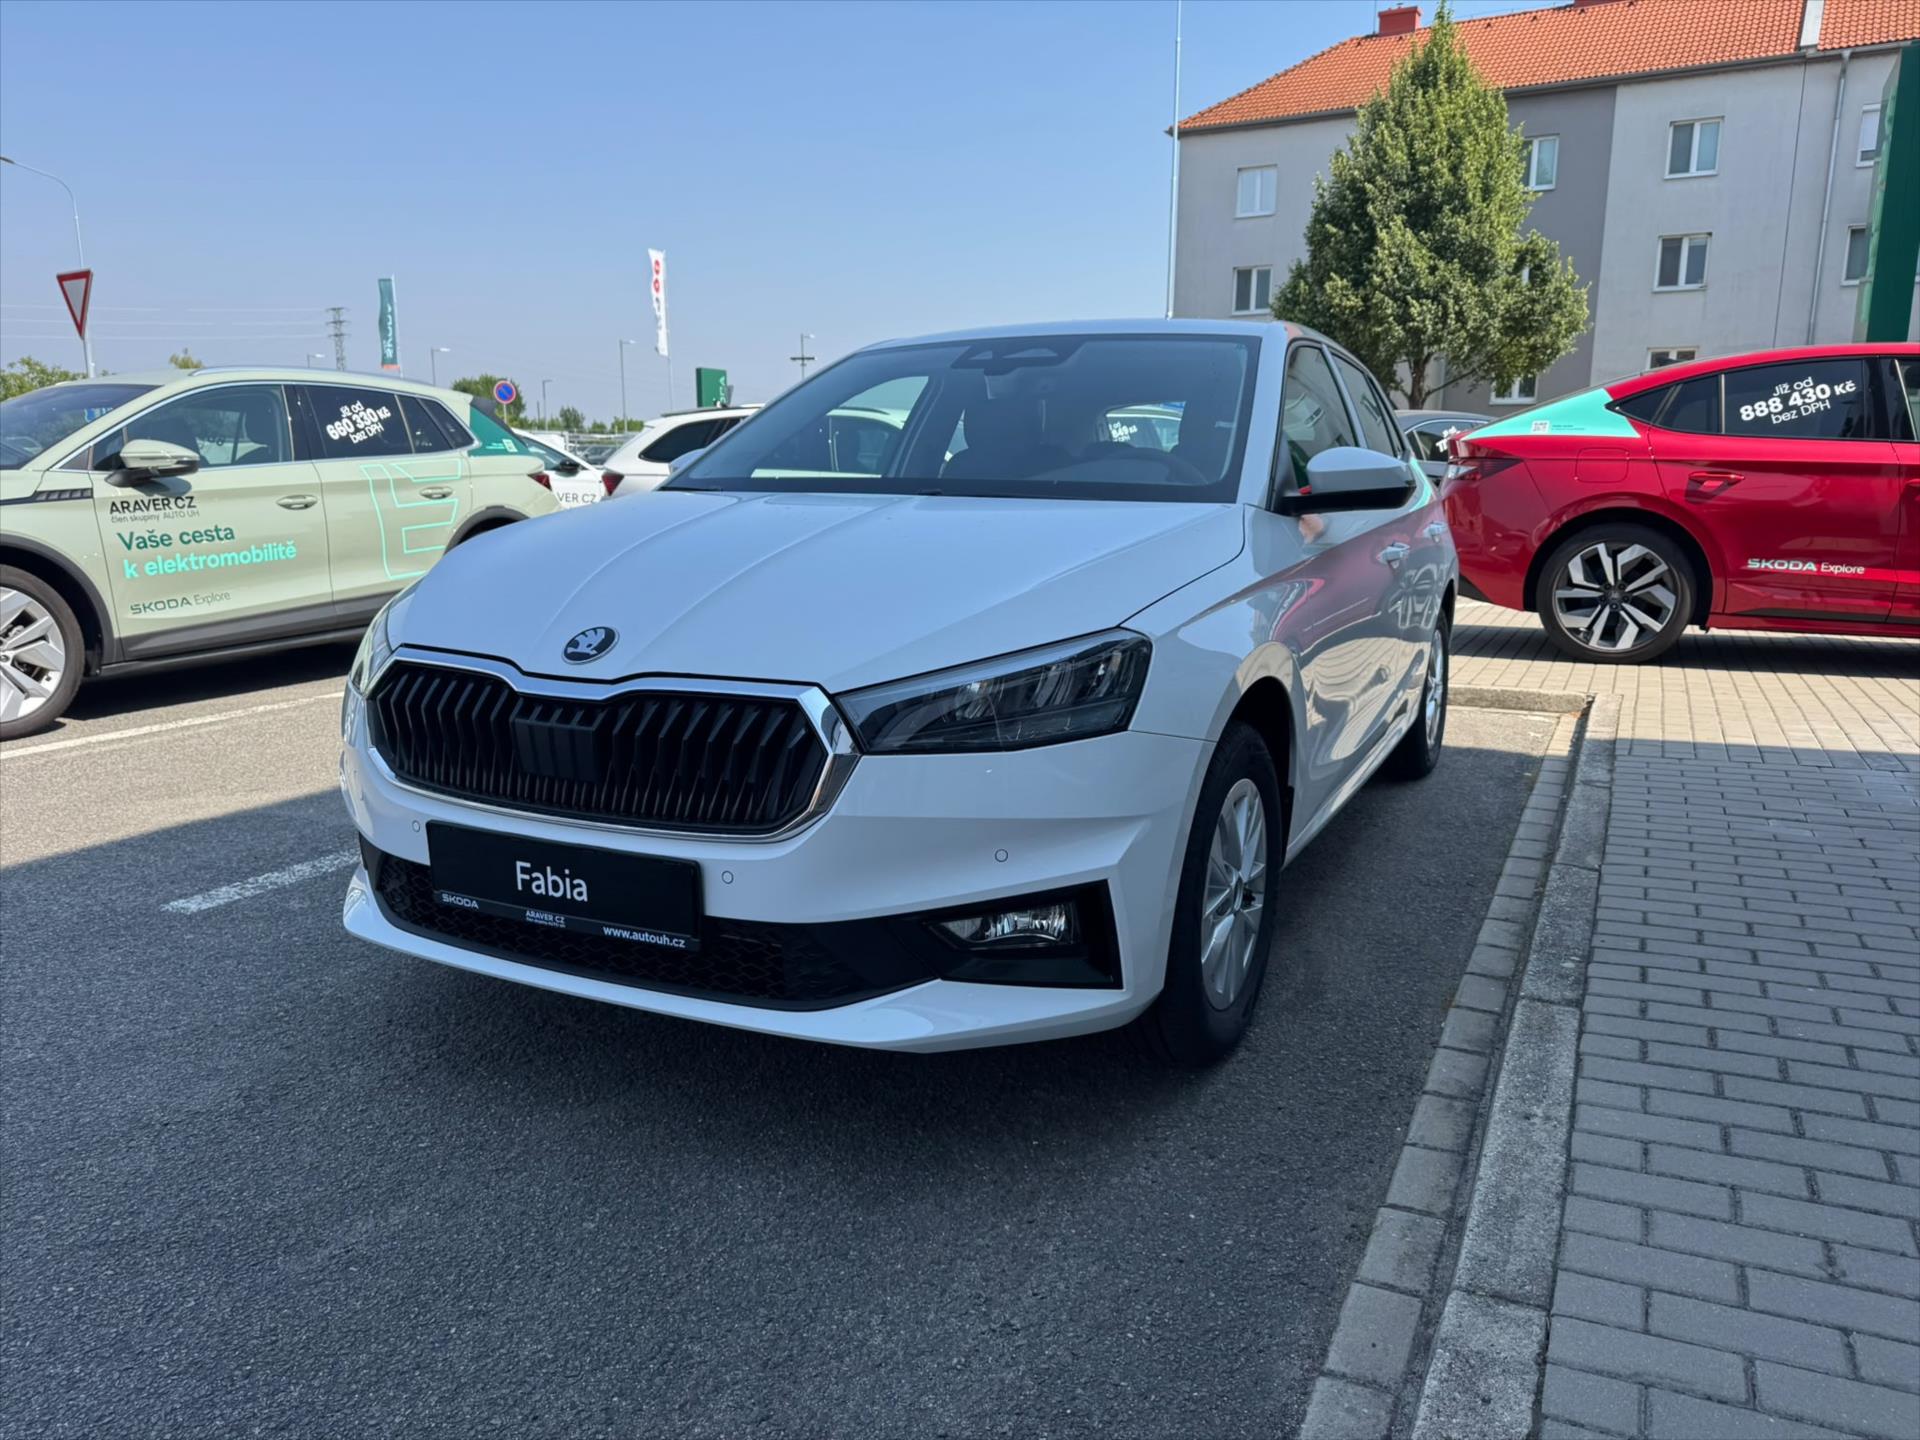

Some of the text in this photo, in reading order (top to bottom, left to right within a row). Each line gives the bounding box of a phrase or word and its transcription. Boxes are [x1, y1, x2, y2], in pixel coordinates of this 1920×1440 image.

[1772, 376, 1814, 397] Již od
[351, 400, 365, 413] od
[1739, 380, 1857, 421] 888 430 Kč
[1770, 399, 1832, 424] bez DPH
[326, 417, 355, 440] 660
[352, 408, 379, 429] 330
[348, 421, 384, 444] bez DPH
[110, 496, 197, 514] ARAVER CZ
[163, 510, 186, 519] AUTO
[117, 525, 235, 551] Vaše cesta
[123, 540, 297, 578] k elektromobilitě
[1820, 562, 1865, 575] Explore
[193, 591, 232, 606] Explore
[516, 860, 588, 902] Fabia
[554, 915, 566, 924] CZ
[602, 925, 686, 948] www.autouh.cz
